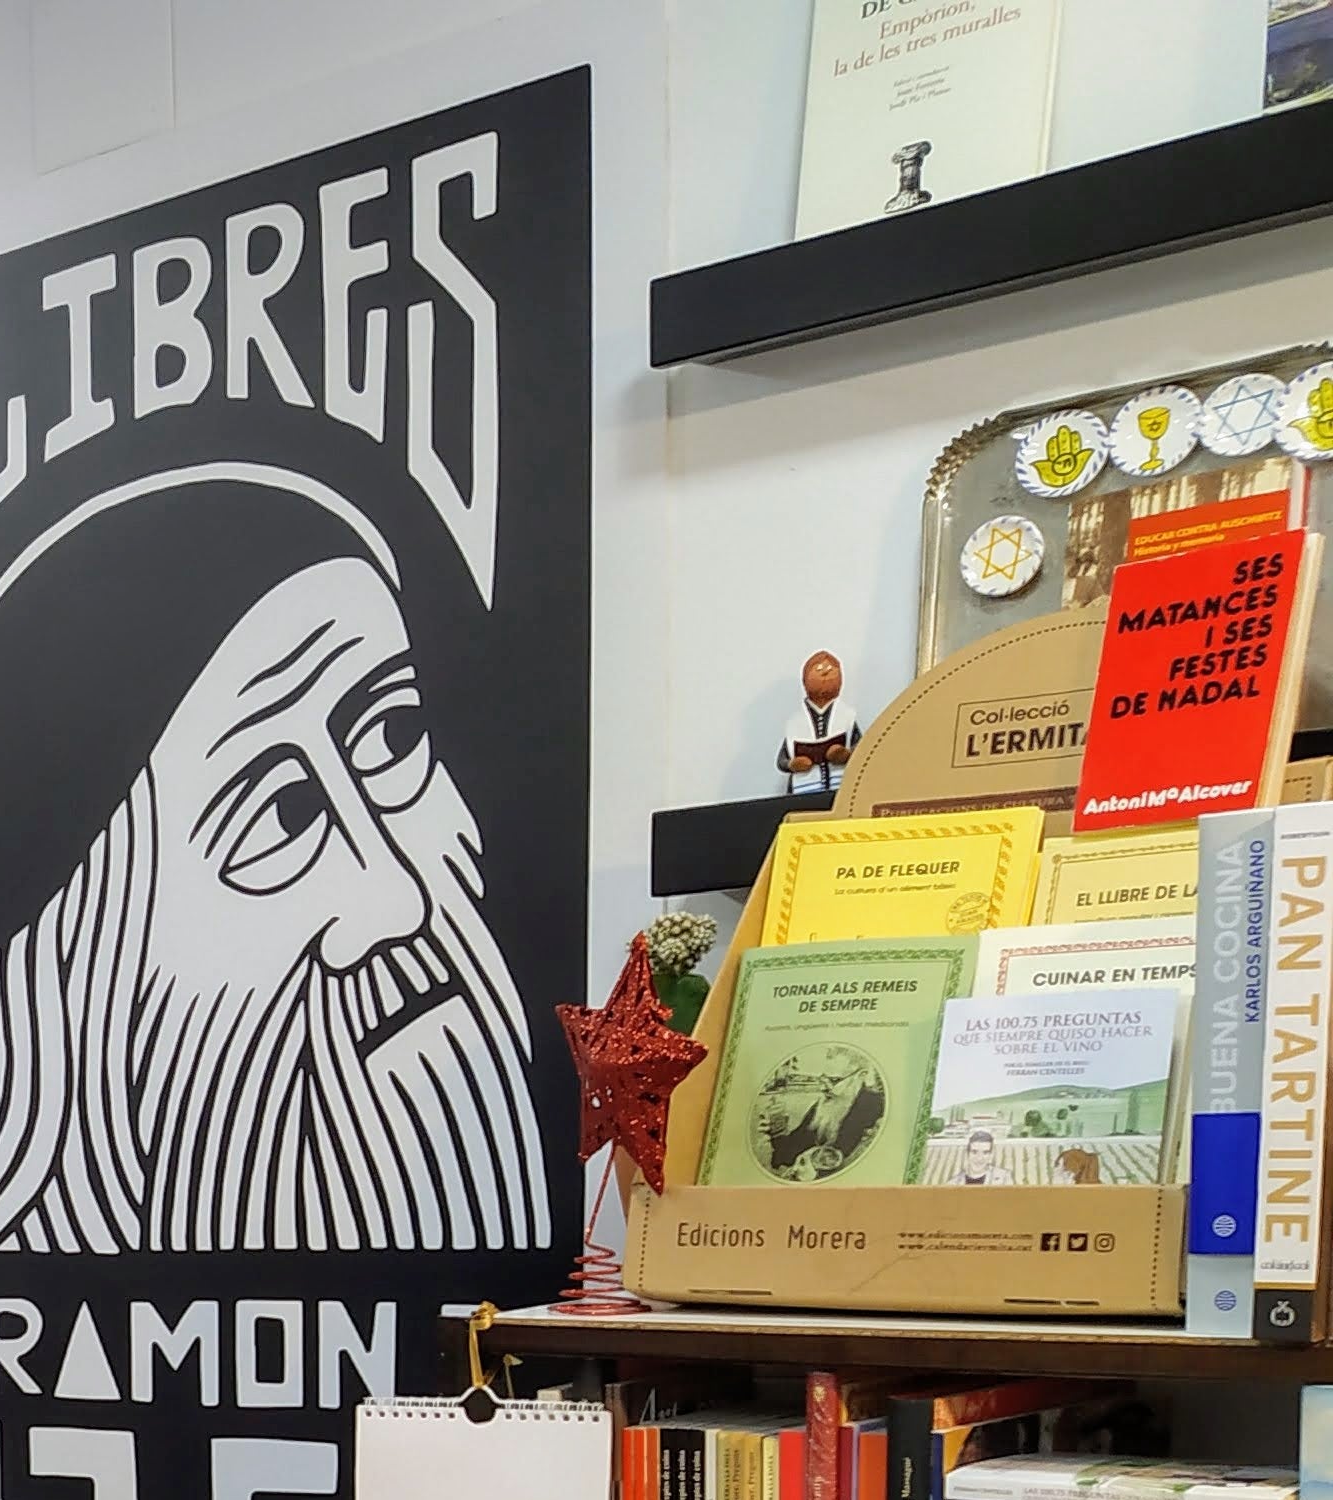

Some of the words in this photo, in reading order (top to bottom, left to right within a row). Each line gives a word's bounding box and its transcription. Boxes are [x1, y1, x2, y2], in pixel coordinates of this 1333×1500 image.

[834, 58, 848, 77] la
[853, 51, 875, 71] de
[879, 44, 901, 63] les
[906, 32, 937, 53] tres
[942, 7, 1022, 42] muralles
[1134, 527, 1173, 546] EDUCAR
[1175, 521, 1218, 540] CONTRA
[1233, 552, 1284, 586] SES
[1117, 584, 1279, 634] MATANCES
[1204, 625, 1214, 649] I
[1223, 613, 1273, 646] SES
[1169, 643, 1268, 681] FESTES
[1109, 694, 1149, 719] DE
[1157, 674, 1260, 713] NADAL
[836, 865, 858, 880] PA
[862, 863, 886, 879] DE
[889, 860, 961, 877] FLEQUER
[1076, 892, 1094, 907] EL
[1097, 888, 1150, 905] LLIBRE
[1155, 884, 1178, 900] DE
[1212, 839, 1246, 981] COCINA
[1247, 839, 1266, 952] ARGUIÑANO
[1277, 854, 1329, 971] PAN
[773, 982, 829, 998] TORNAR
[831, 980, 859, 996] ALS
[863, 978, 917, 994] REMEIS
[1032, 969, 1105, 987] CUINAR
[1112, 966, 1135, 982] EN
[1141, 963, 1197, 981] TEMPS
[1244, 956, 1261, 1025] KARLOS
[798, 1000, 816, 1014] DE
[819, 997, 878, 1013] SEMPRE
[965, 1015, 991, 1032] LAS
[1042, 1010, 1142, 1029] PREGUNTAS
[953, 1031, 984, 1046] QUE
[986, 1028, 1043, 1044] SIEMPRE
[1046, 1026, 1097, 1042] QUISO
[1101, 1024, 1153, 1039] HACER
[993, 1041, 1041, 1055] SOBRE
[1044, 1040, 1060, 1054] EL
[1064, 1039, 1103, 1053] VINO
[1209, 998, 1241, 1115] BUENA
[1262, 993, 1321, 1245] TARTINE
[677, 1222, 766, 1248] Edicions
[787, 1225, 867, 1251] Morera
